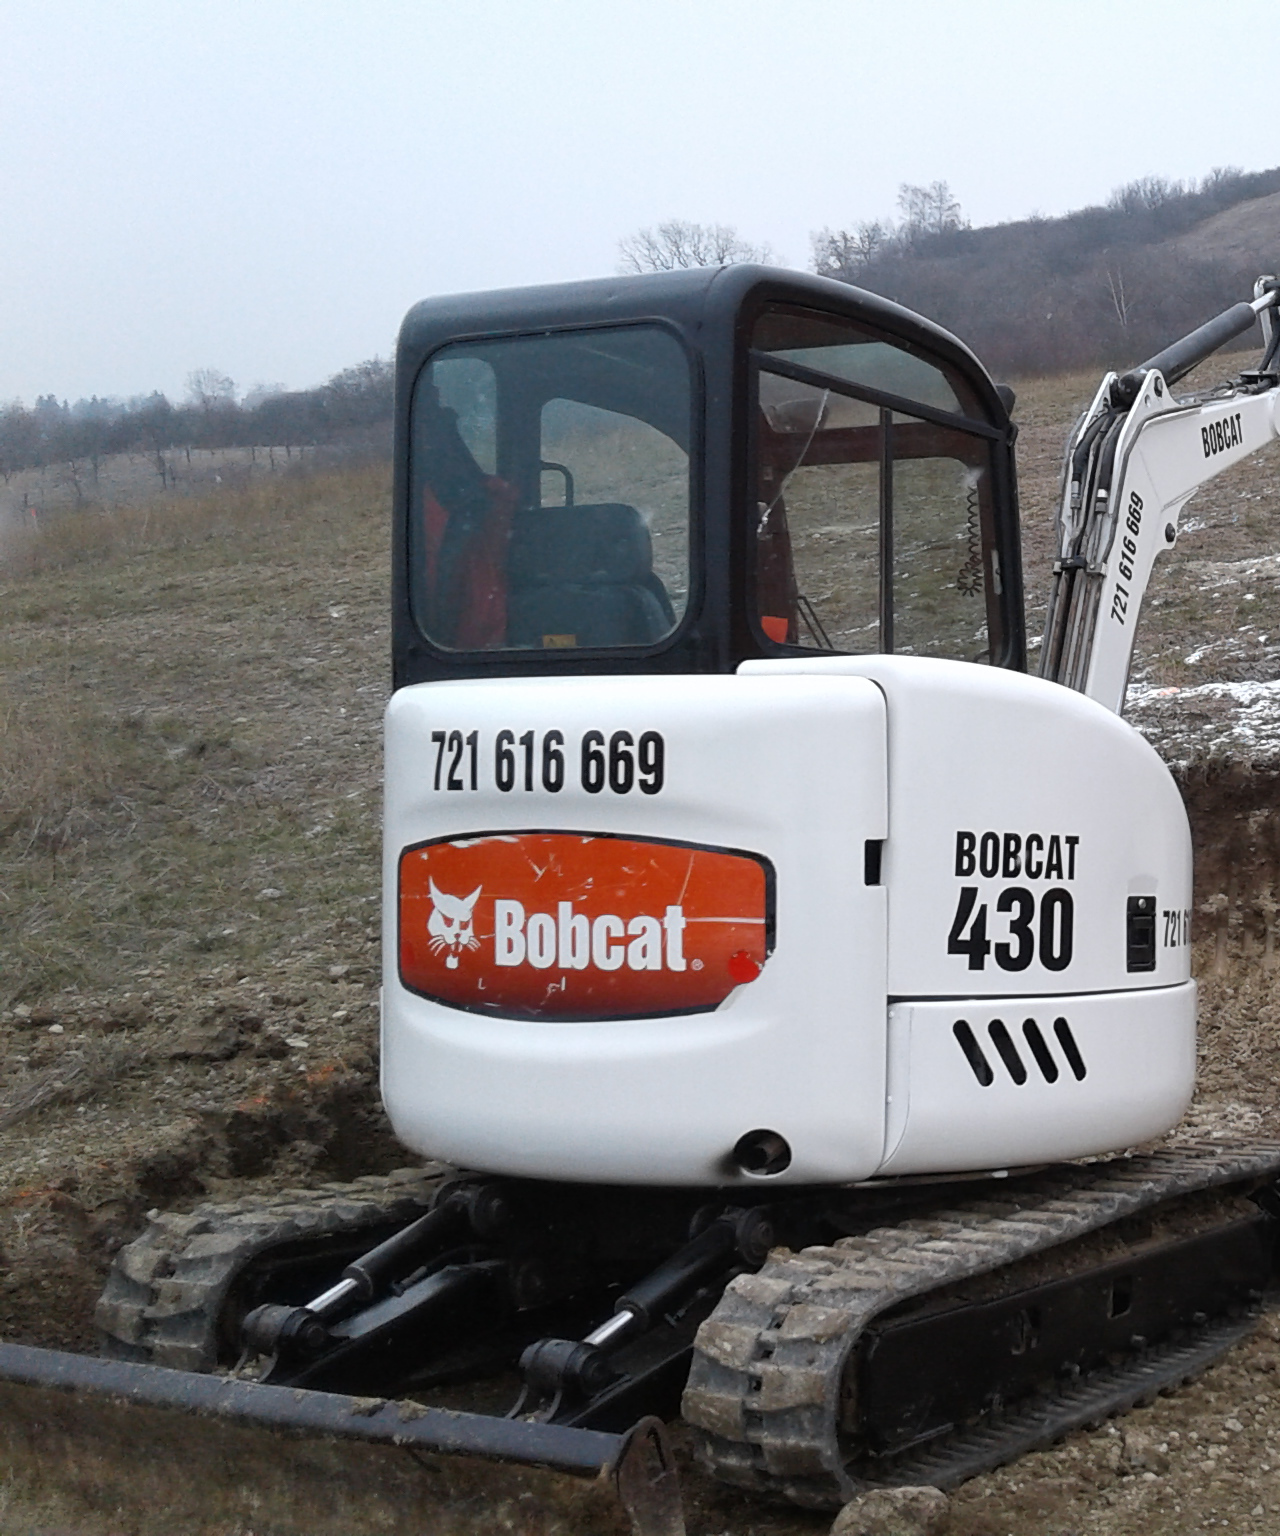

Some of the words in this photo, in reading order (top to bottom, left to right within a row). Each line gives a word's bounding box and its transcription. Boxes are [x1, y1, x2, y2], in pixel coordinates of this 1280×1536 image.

[1201, 413, 1242, 458] BOBCAT
[1126, 491, 1143, 536] 669
[1119, 535, 1136, 581] 616
[1111, 583, 1129, 625] 721
[431, 730, 478, 790] 721
[495, 729, 564, 793] 616
[581, 730, 664, 794] 669
[955, 831, 1079, 880] BOBCAT
[495, 899, 686, 971] Bobcat
[947, 887, 1073, 972] 430
[1163, 910, 1181, 948] 721
